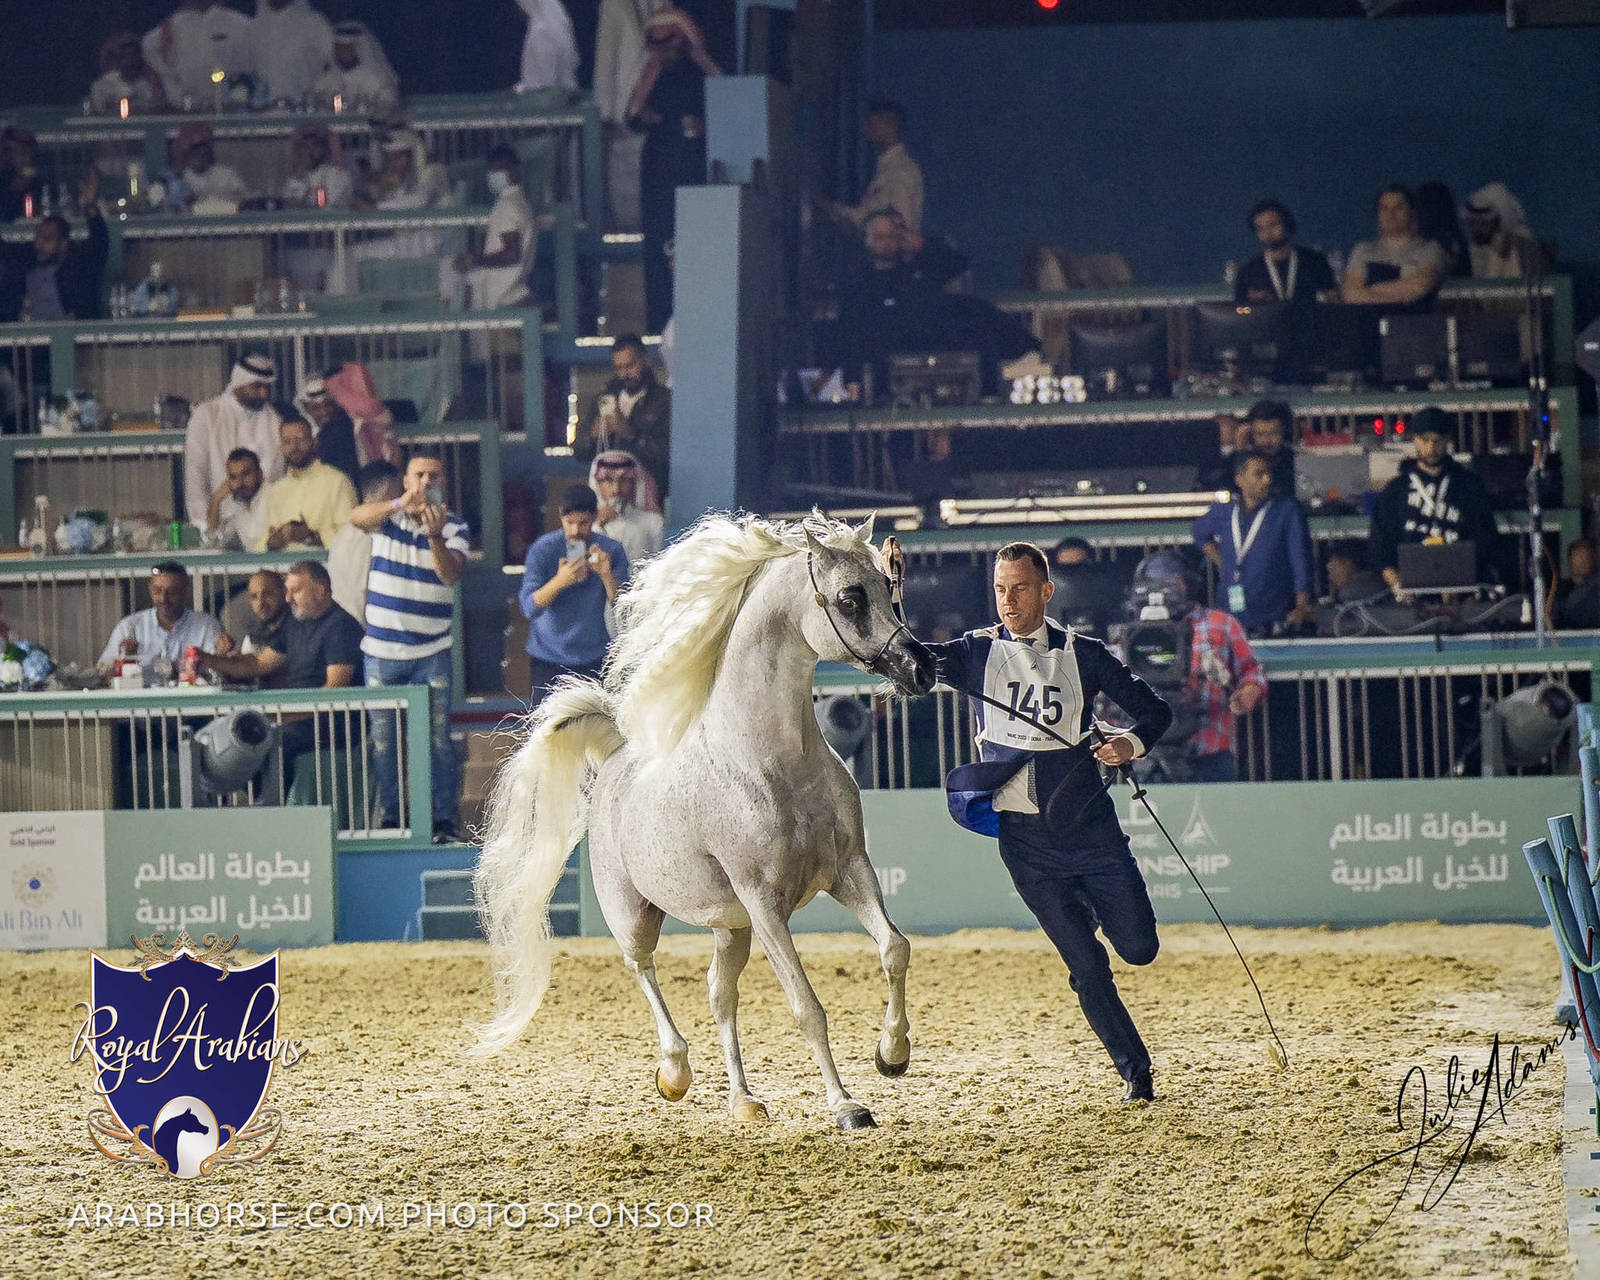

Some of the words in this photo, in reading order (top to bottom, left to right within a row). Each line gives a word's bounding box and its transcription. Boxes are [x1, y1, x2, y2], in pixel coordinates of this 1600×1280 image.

[1007, 681, 1063, 726] 145
[1329, 812, 1412, 850] العالم
[1420, 809, 1508, 847] بطولة
[134, 853, 215, 890] العالم
[224, 851, 312, 886] بطولة
[1330, 856, 1425, 892] العربية
[1432, 853, 1509, 891] للخيل
[20, 911, 52, 930] Bin
[58, 909, 83, 930] Ali
[135, 896, 227, 931] العربية
[236, 893, 313, 929] للخيل
